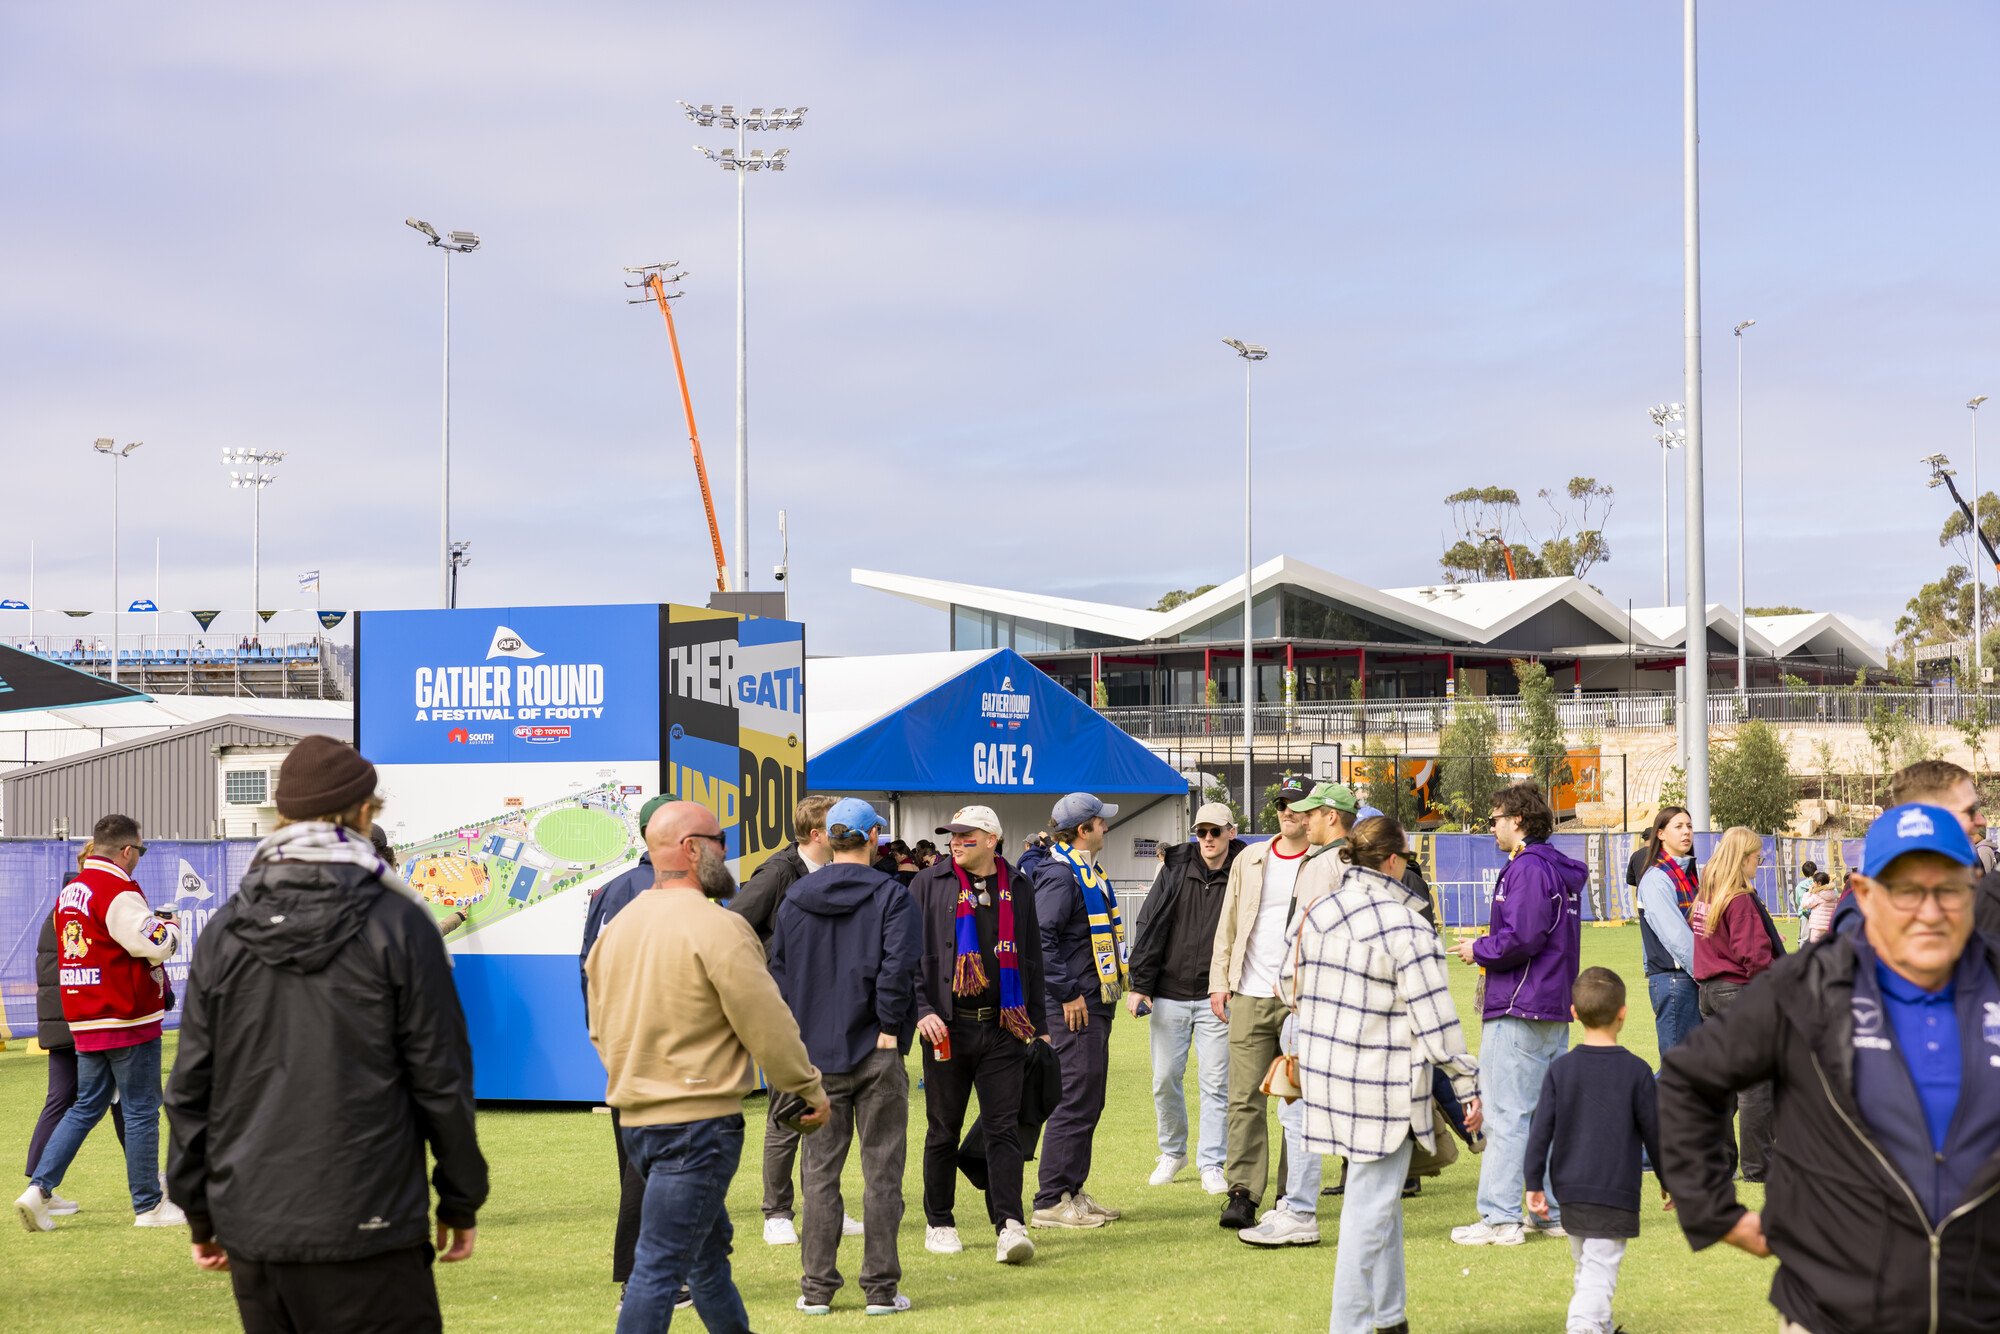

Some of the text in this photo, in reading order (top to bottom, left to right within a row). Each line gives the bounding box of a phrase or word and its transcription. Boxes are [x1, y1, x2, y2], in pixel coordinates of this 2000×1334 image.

[499, 638, 520, 649] AFL
[415, 664, 604, 708] GATHER ROUND
[415, 706, 604, 721] A FESTIVAL OF FOOTY
[468, 733, 494, 741] SOUTH
[514, 726, 569, 736] AFL TOYOTA
[973, 742, 1034, 785] GATE 2
[183, 877, 200, 889] AFL
